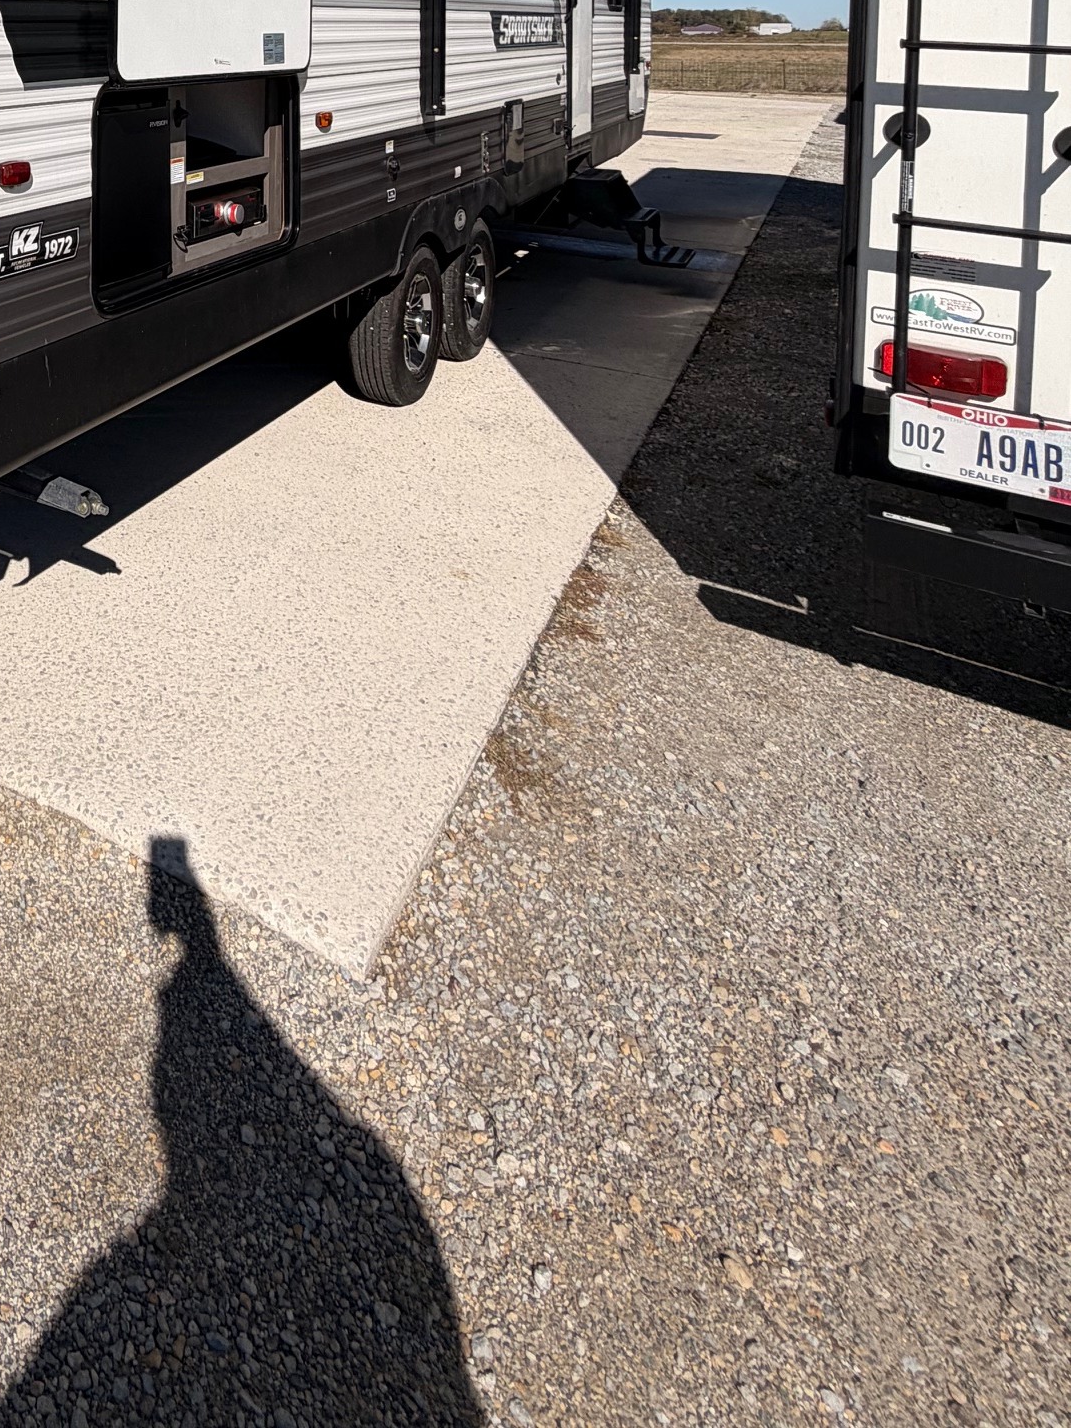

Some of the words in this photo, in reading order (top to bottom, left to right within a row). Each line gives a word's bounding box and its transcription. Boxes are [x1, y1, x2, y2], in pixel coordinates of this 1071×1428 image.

[499, 15, 554, 44] SPORTSMEN
[12, 226, 40, 256] KZ
[44, 235, 73, 260] 1972
[961, 408, 1009, 427] OHIO
[901, 420, 945, 454] 002
[976, 430, 1063, 483] A9AB
[959, 468, 1009, 486] DEALER
